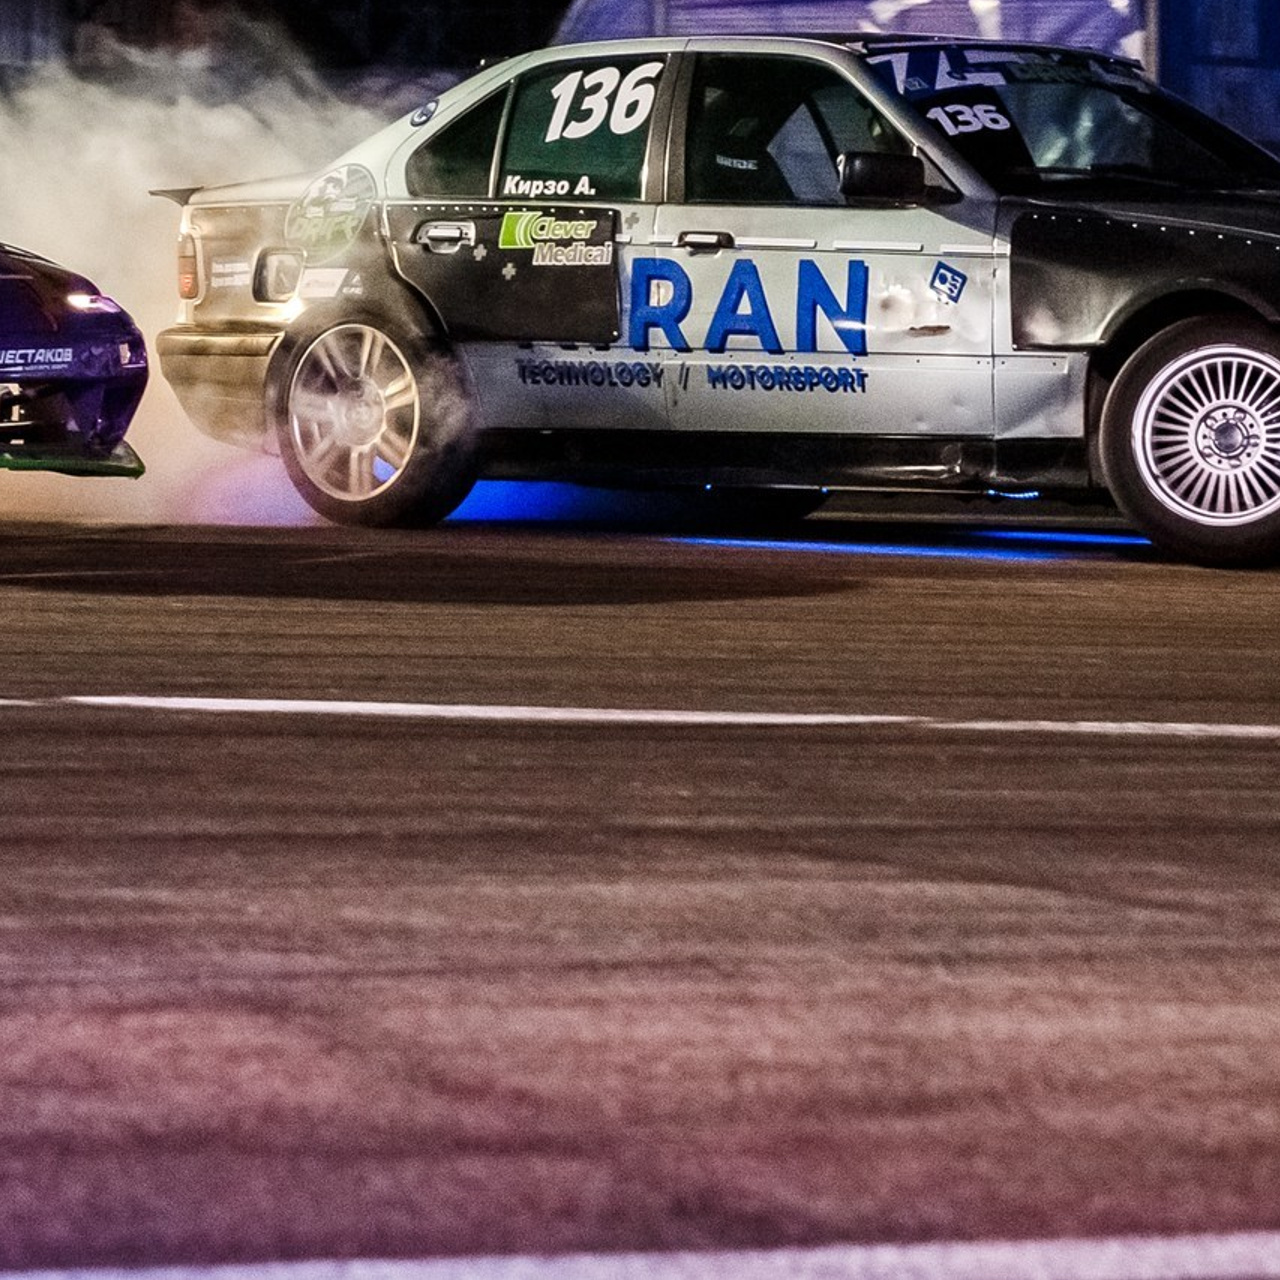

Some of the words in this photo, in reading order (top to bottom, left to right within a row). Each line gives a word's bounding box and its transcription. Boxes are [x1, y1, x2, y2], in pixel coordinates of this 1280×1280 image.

[545, 61, 665, 143] 136
[926, 102, 1011, 136] 136
[503, 175, 568, 198] Кирзо
[531, 217, 597, 240] Clever
[532, 241, 613, 266] Medical
[628, 257, 869, 356] RAN
[515, 357, 664, 388] TECHNOLOGY
[706, 363, 869, 393] MOTORSPORT
